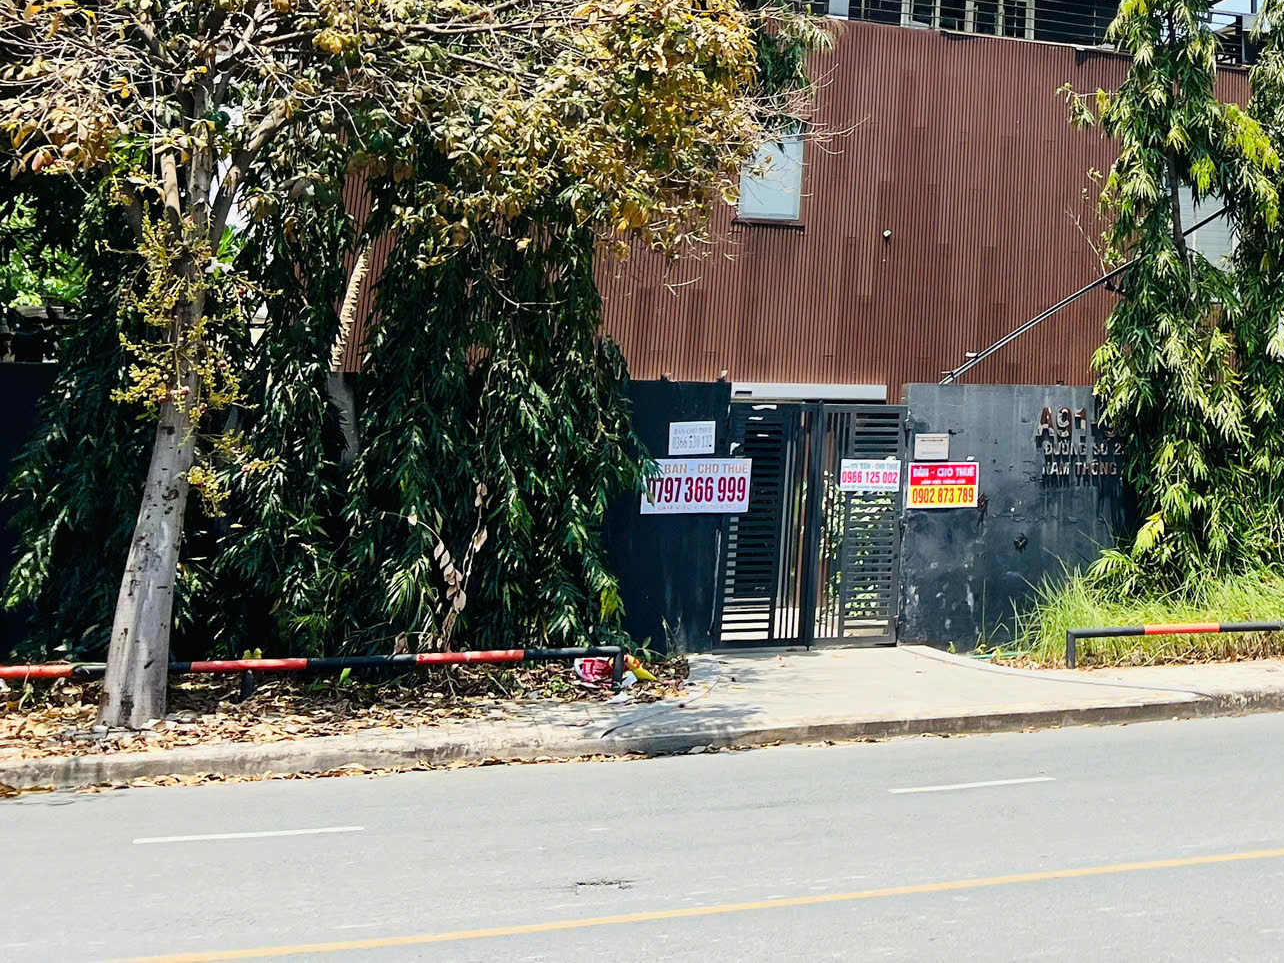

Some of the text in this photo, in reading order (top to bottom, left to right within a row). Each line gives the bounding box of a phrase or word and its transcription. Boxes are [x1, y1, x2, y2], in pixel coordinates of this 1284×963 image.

[697, 463, 719, 474] CHO
[937, 467, 954, 478] CHO
[842, 471, 898, 484] 0966 125 002
[684, 477, 714, 503] 366
[717, 477, 746, 503] 999
[912, 487, 974, 504] 0902 873 789
